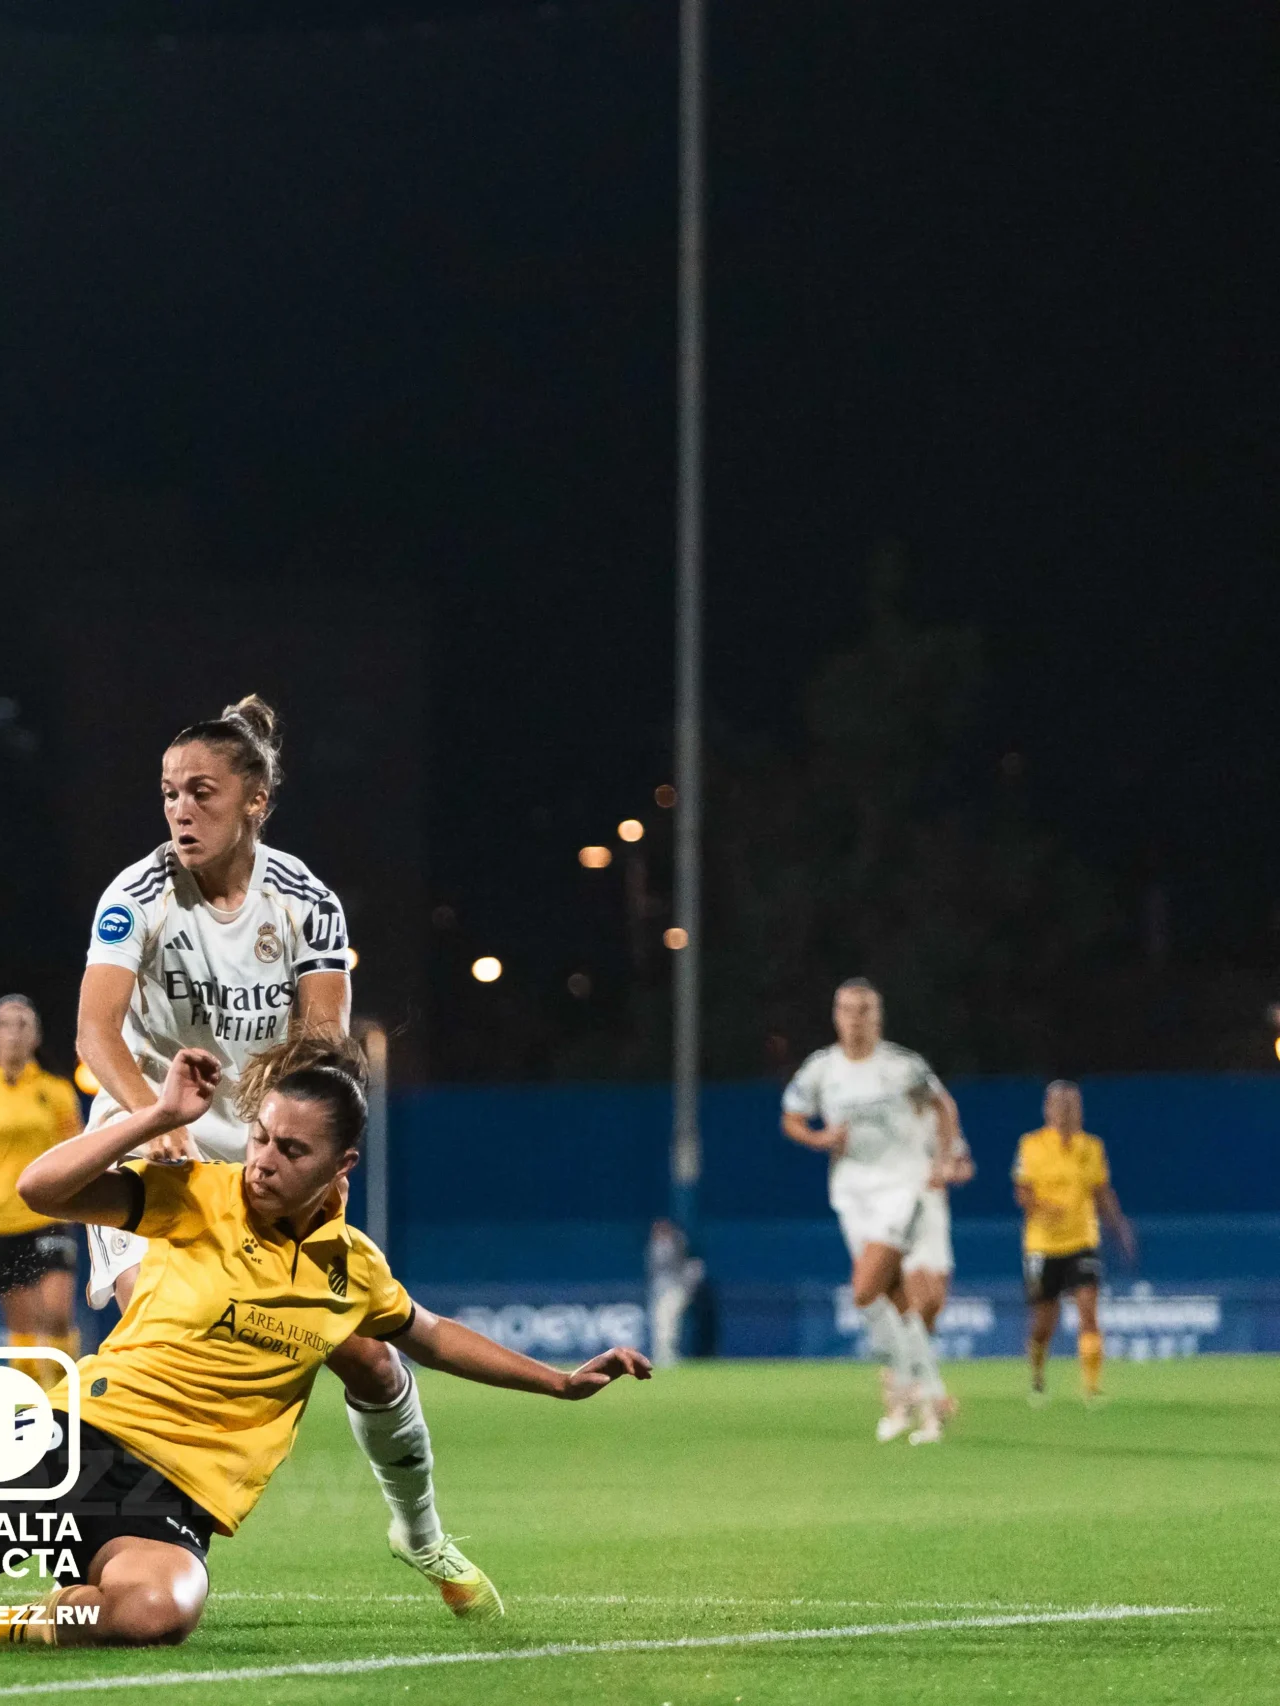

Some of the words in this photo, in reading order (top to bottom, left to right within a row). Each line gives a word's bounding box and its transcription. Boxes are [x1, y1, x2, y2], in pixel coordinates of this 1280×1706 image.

[102, 922, 117, 932] Liga
[308, 903, 345, 953] hp
[165, 970, 294, 1012] Emirates
[215, 1011, 277, 1041] BETTER
[238, 1328, 300, 1361] GLOBAL
